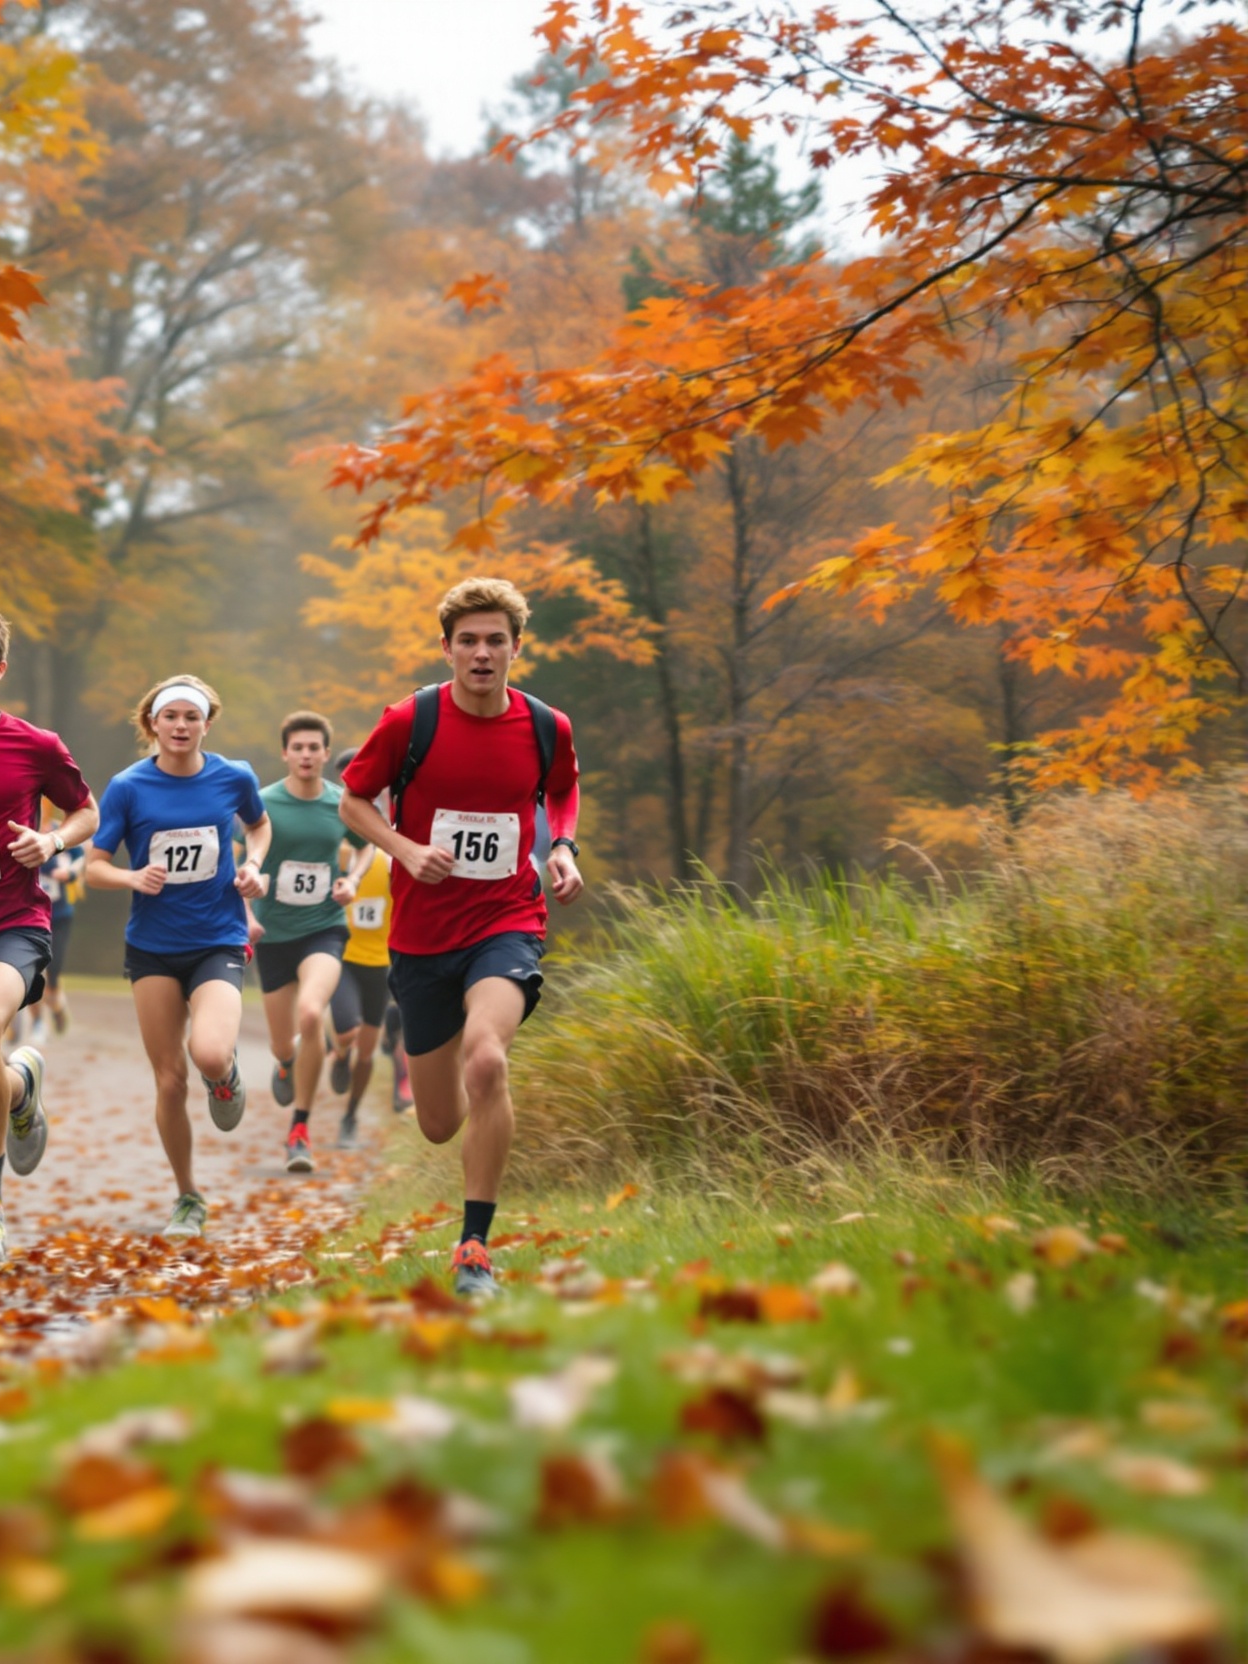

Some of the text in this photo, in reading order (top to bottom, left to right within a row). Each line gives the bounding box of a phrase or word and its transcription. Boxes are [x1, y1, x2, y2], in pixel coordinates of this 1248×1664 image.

[165, 844, 202, 873] 127
[452, 830, 499, 862] 156
[293, 873, 316, 894] 53
